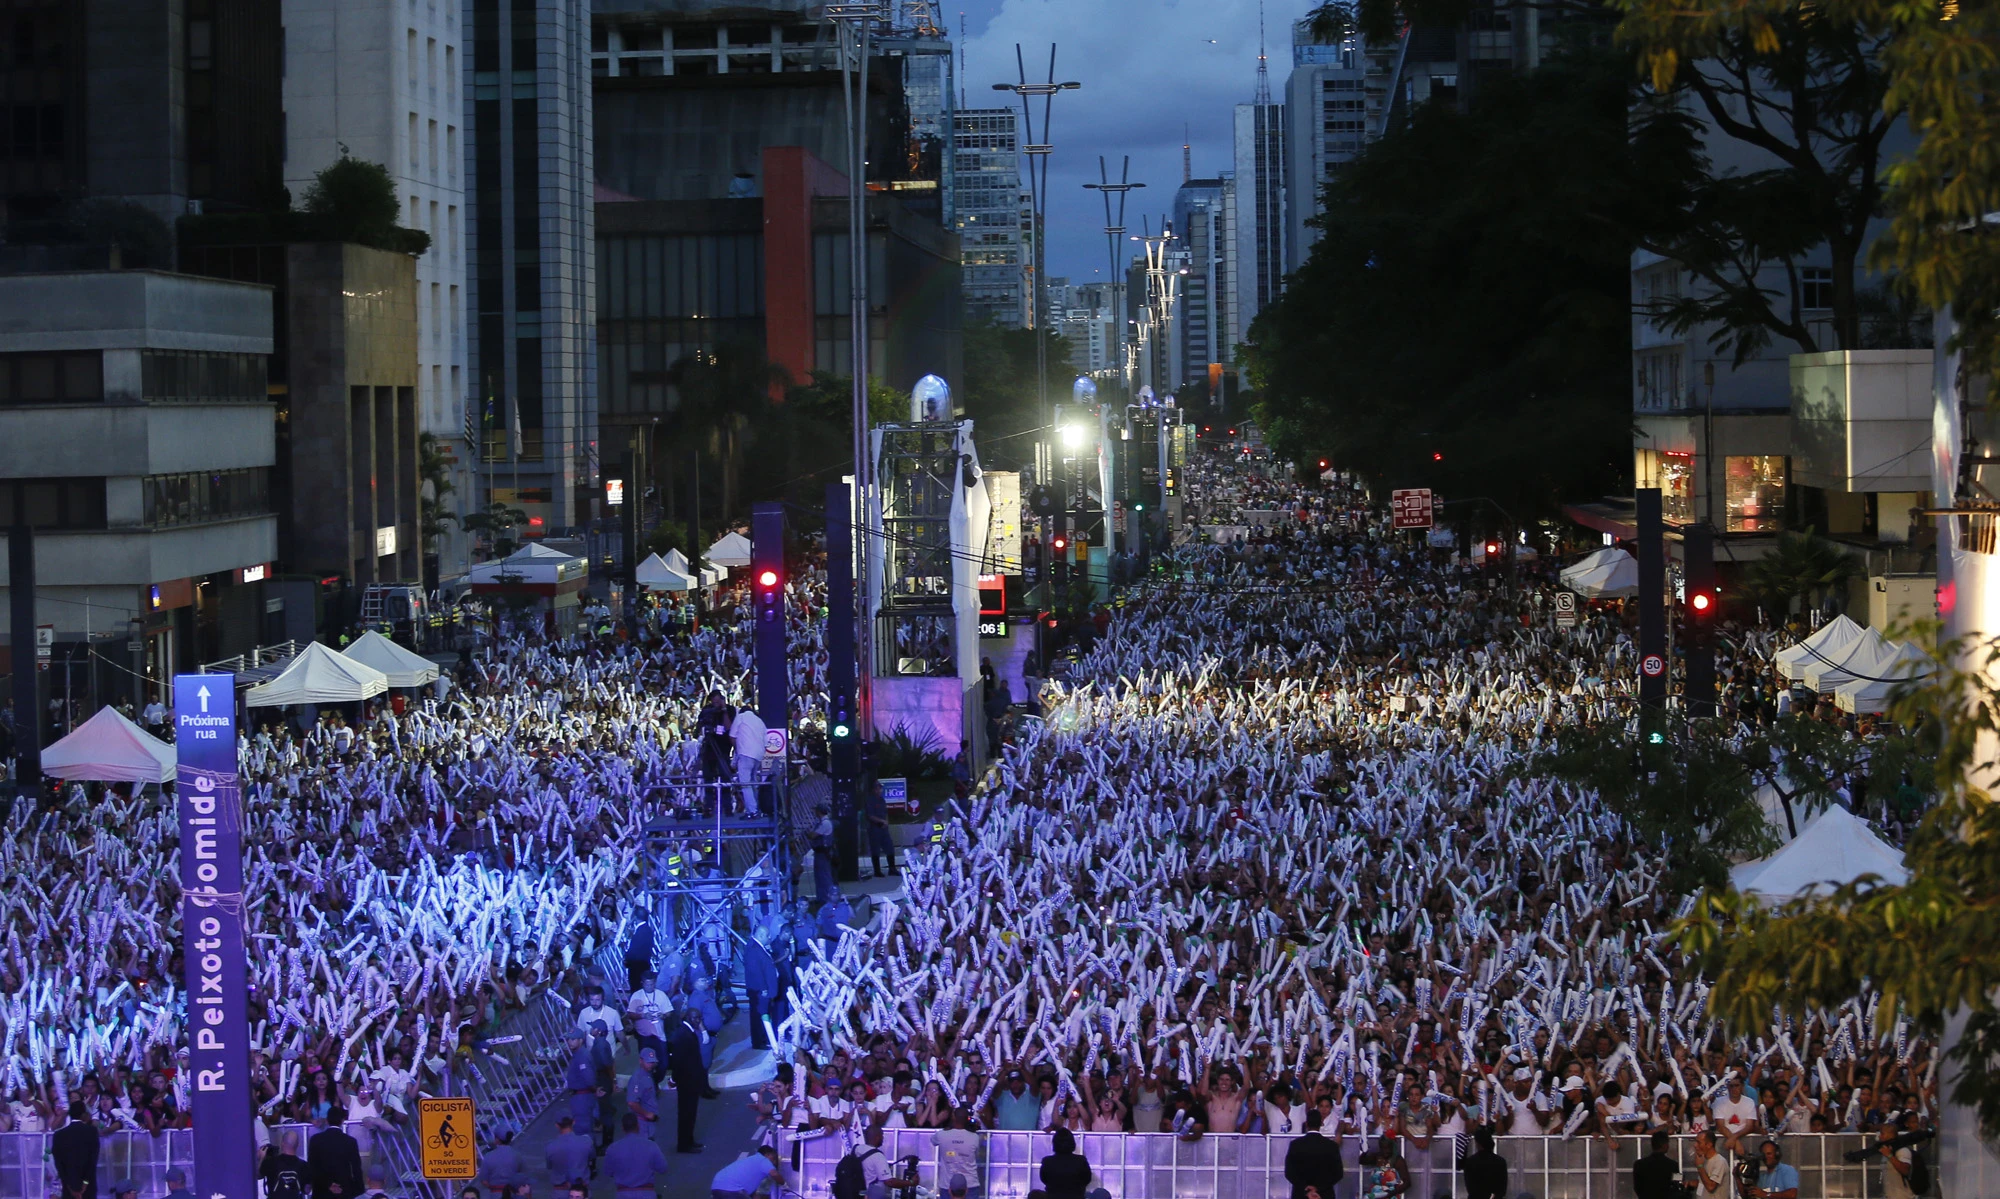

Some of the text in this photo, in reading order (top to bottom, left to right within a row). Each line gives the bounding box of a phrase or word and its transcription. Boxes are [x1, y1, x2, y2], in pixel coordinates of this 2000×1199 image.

[1646, 660, 1660, 669] 50
[181, 715, 230, 726] Próxima
[196, 730, 217, 739] rua
[885, 789, 904, 797] HCor
[188, 776, 225, 1091] R. Peixoto Gomide
[423, 1103, 470, 1112] CICLISTA
